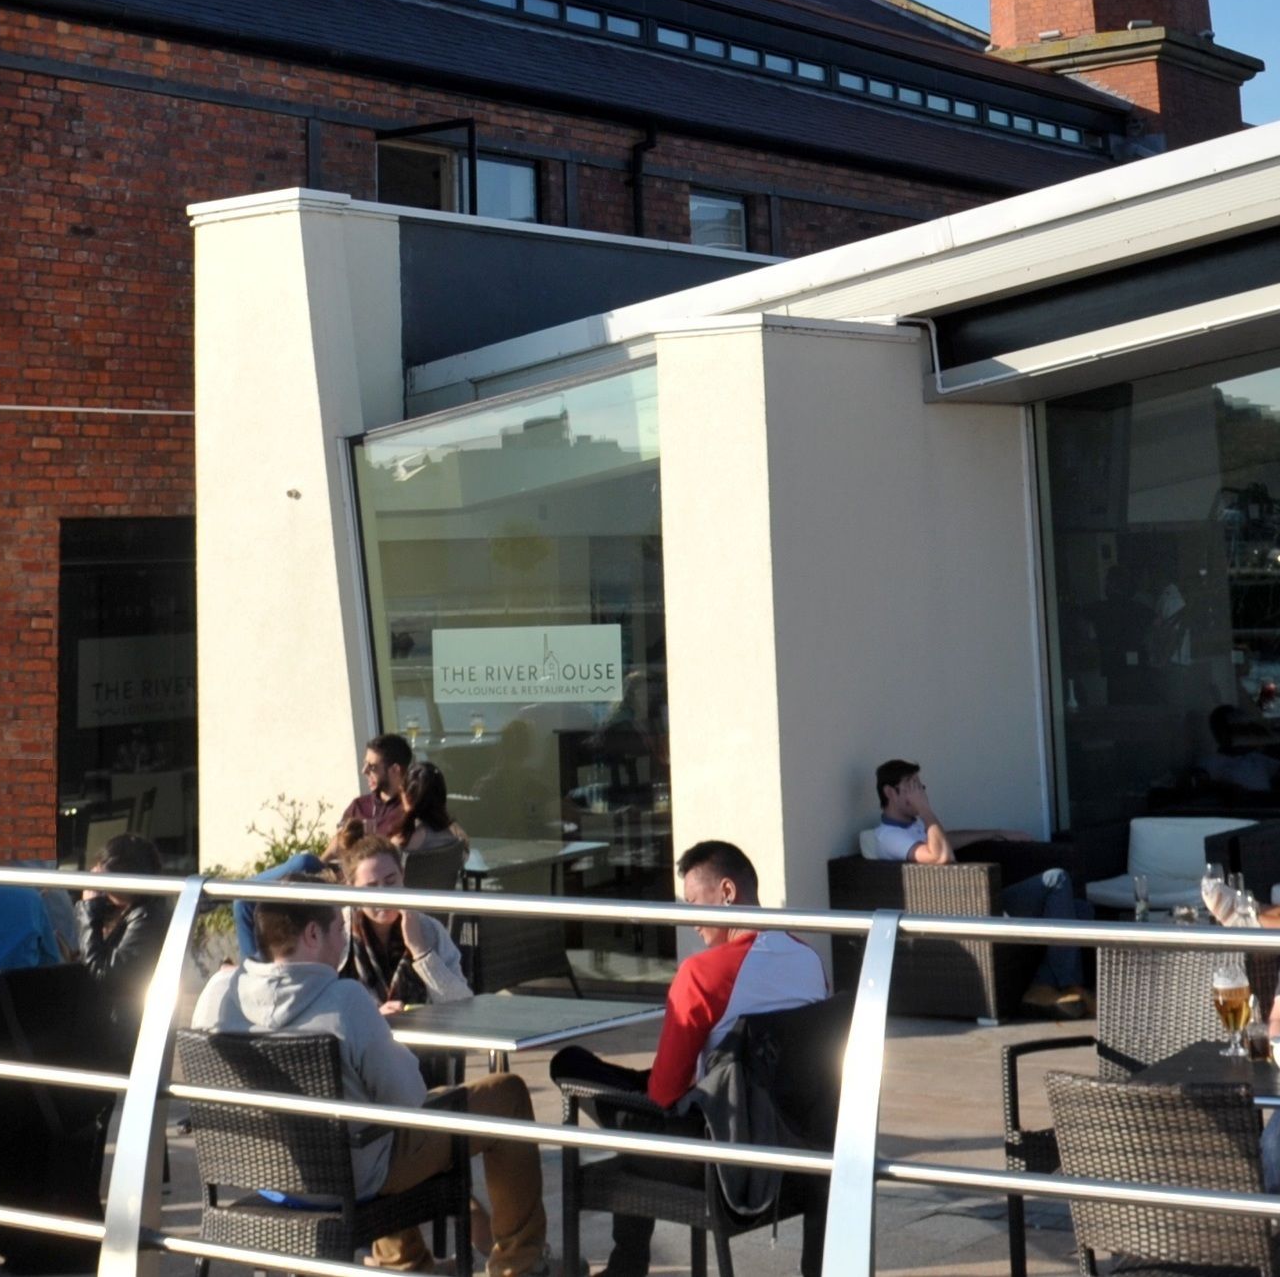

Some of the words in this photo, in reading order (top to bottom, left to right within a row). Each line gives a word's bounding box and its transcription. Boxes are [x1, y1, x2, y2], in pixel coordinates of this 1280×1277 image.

[440, 666, 477, 683] THE
[485, 664, 538, 682] RIVER
[91, 681, 133, 702] THE
[468, 685, 508, 696] LOUNGE
[511, 685, 518, 696] &
[521, 684, 585, 696] RESTAURANT
